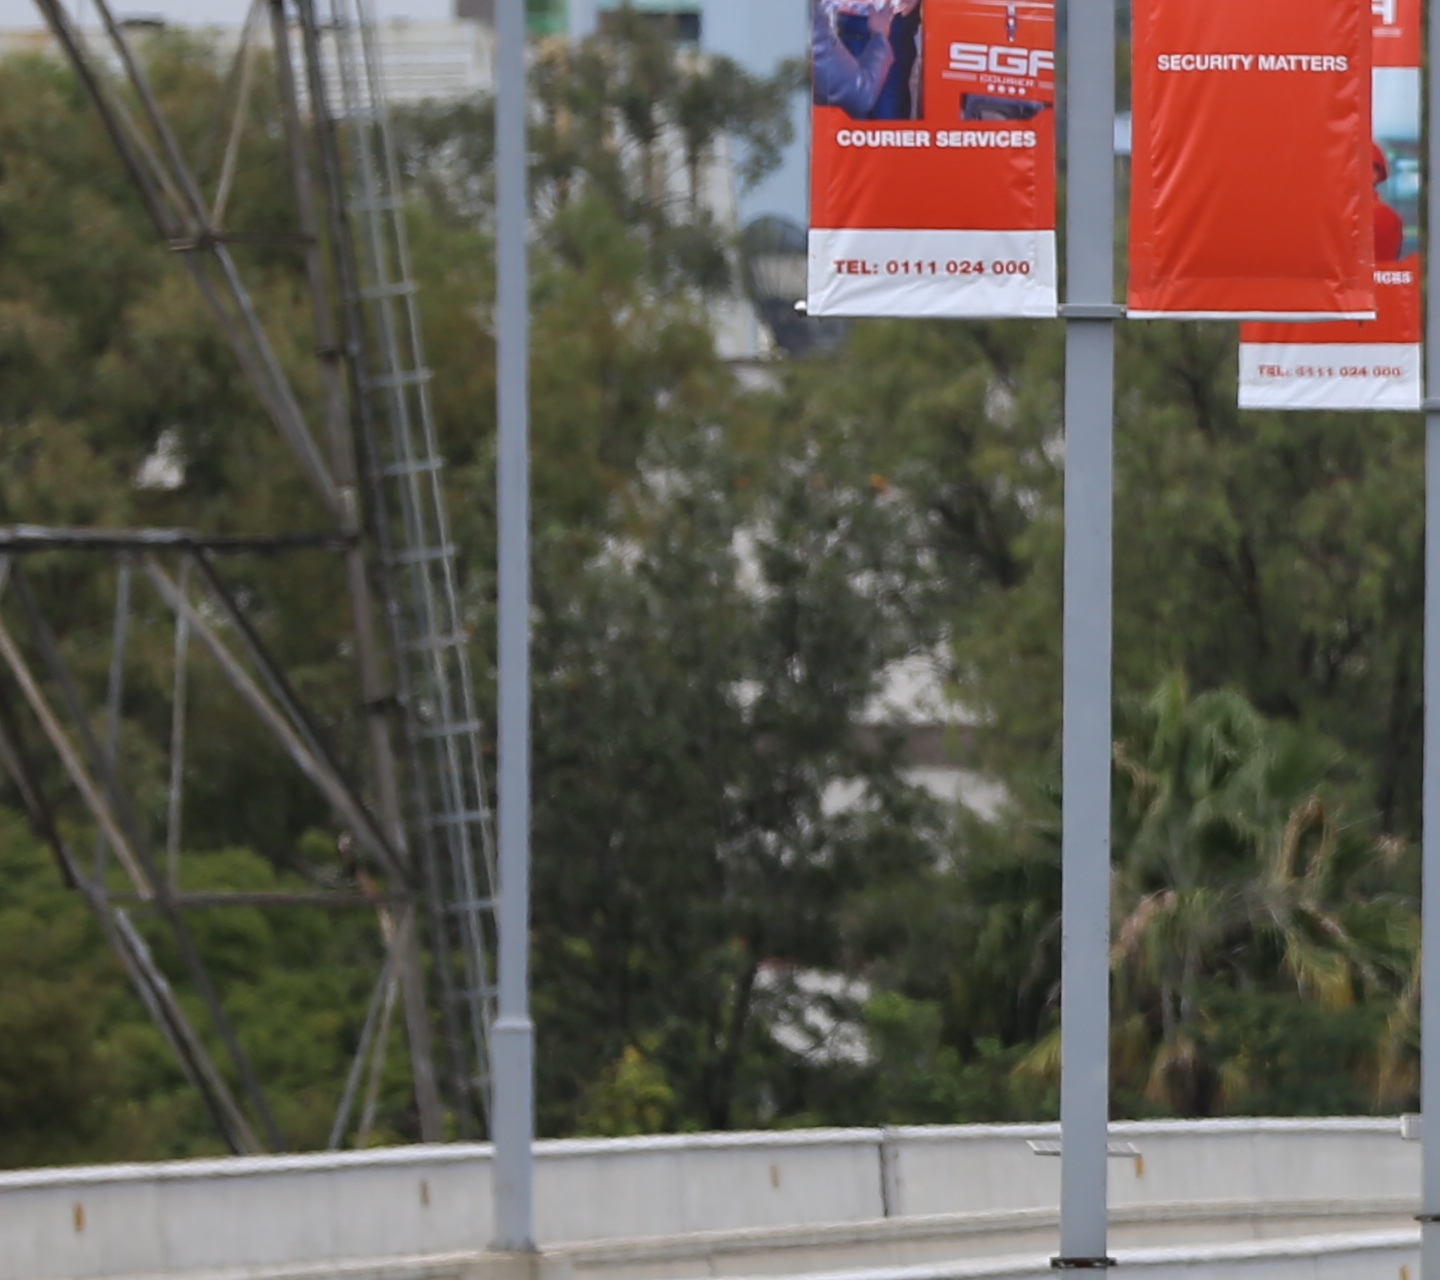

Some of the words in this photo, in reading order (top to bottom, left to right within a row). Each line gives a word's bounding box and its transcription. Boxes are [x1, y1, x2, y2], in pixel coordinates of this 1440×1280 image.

[1157, 54, 1254, 71] SECURITY
[1258, 54, 1348, 72] MATTERS
[836, 130, 931, 147] COURIER
[936, 130, 1037, 148] SERVICES
[835, 260, 879, 275] TEL:
[886, 260, 937, 275] 0111
[946, 260, 985, 275] 024
[991, 260, 1031, 276] 000
